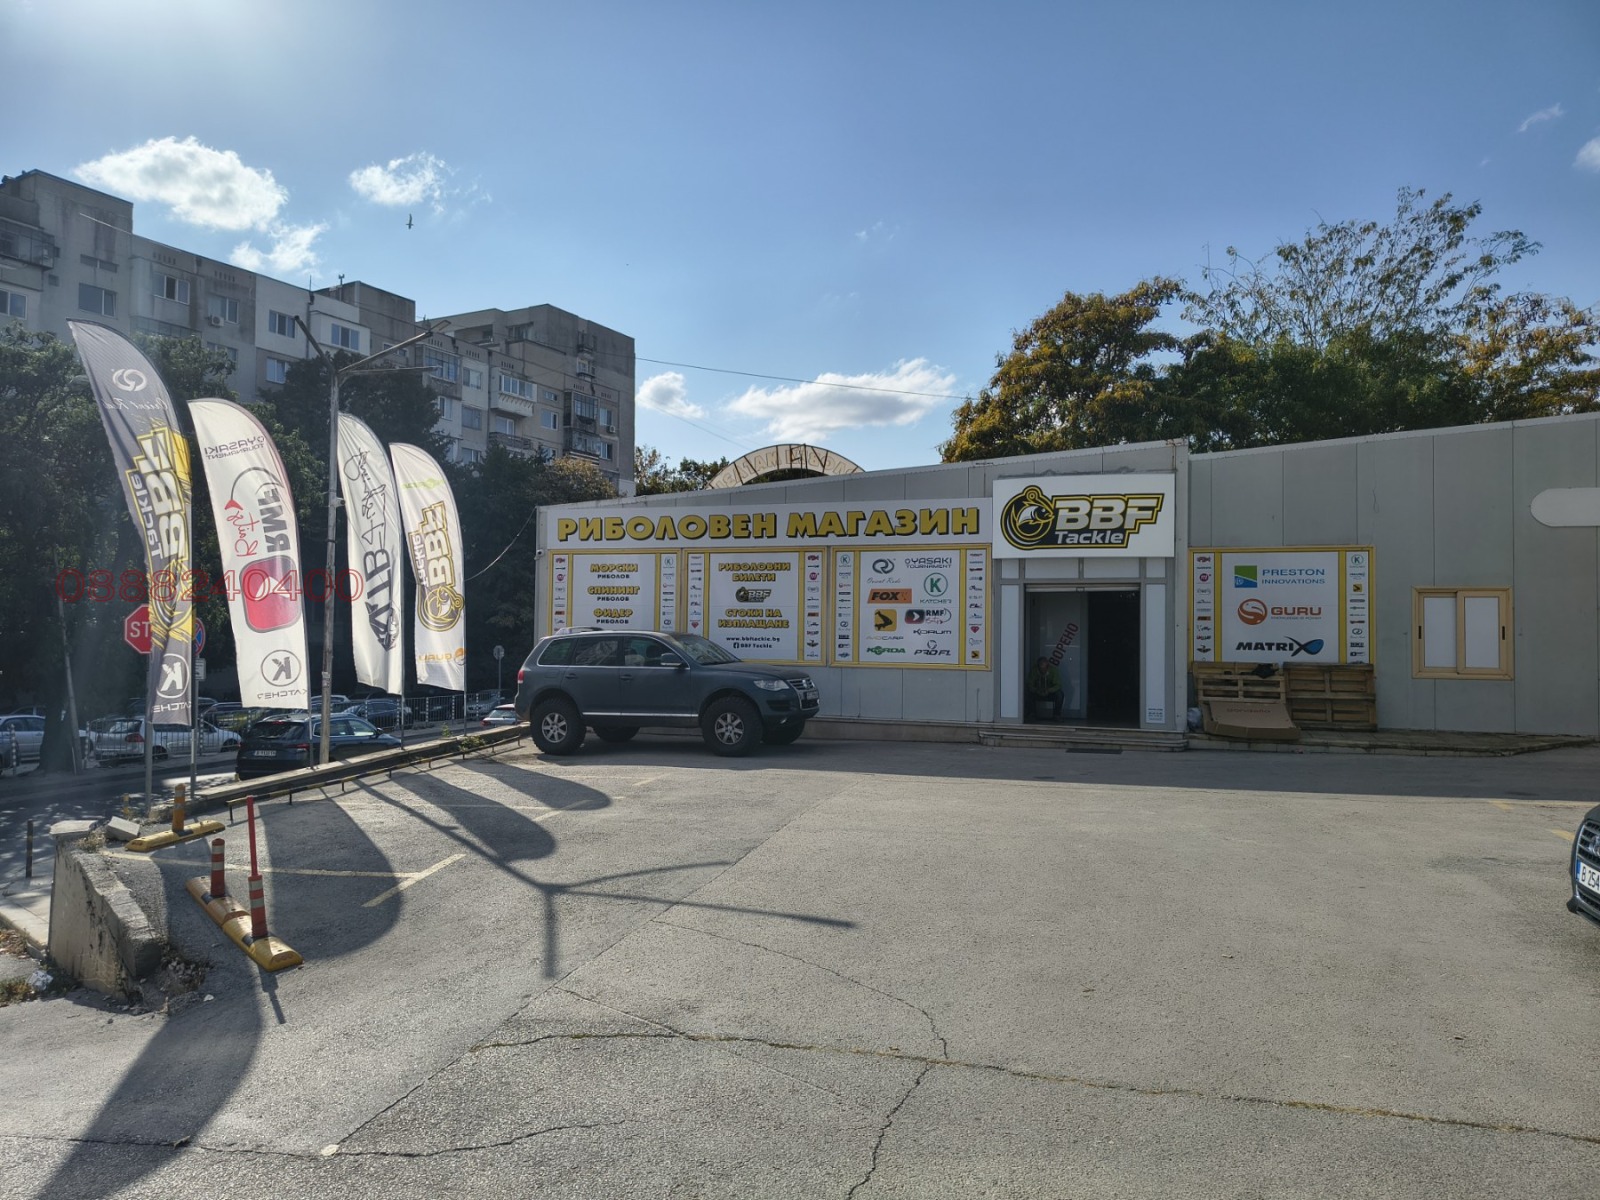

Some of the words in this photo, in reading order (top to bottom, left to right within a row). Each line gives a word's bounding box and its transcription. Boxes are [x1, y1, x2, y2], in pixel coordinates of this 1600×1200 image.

[1055, 498, 1158, 531] BBF
[557, 512, 777, 542] РИБОЛОВЕН
[786, 507, 980, 539] МАГАЗИН
[1055, 530, 1124, 544] Tackle
[905, 557, 952, 565] OYASAKI
[590, 563, 639, 573] МОРСКИ
[718, 562, 791, 571] РИБОЛОВНИ
[1262, 568, 1325, 576] PRESTON
[732, 573, 776, 582] БИЛЕТИ
[587, 585, 640, 595] СПИНИНГ
[871, 591, 901, 601] FOX
[593, 608, 634, 618] ФИДЕР
[725, 608, 763, 618] СТОКИ
[765, 608, 783, 617] НА
[1271, 606, 1322, 616] GURU
[718, 619, 790, 629] ИЗПЛАЩАНЕ
[130, 621, 150, 638] ST
[1049, 622, 1079, 667] ВОРЕНО
